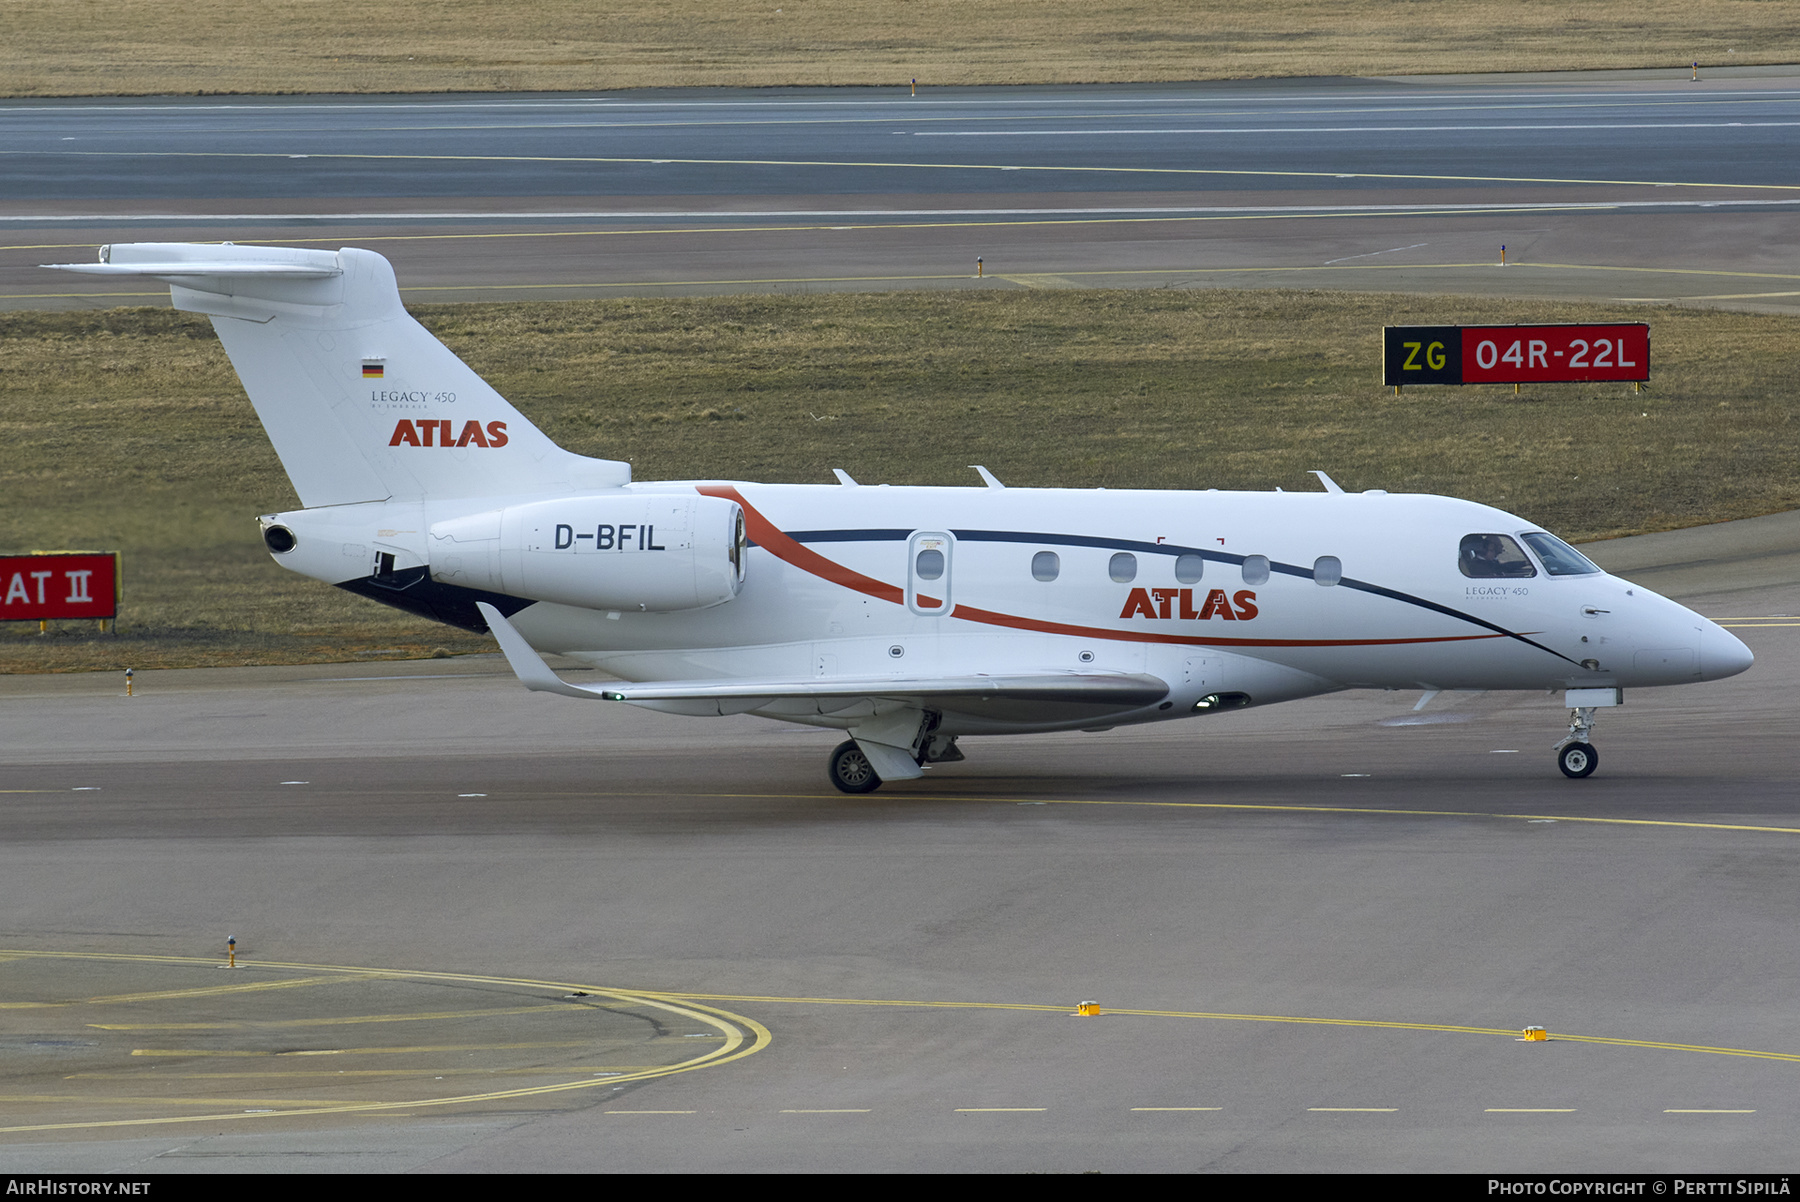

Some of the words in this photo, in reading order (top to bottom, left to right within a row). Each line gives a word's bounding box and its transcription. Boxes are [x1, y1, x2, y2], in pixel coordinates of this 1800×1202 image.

[1403, 341, 1446, 370] ZG
[1476, 338, 1636, 369] 04R-22L
[434, 392, 456, 403] 450
[388, 419, 509, 448] ATLAS
[555, 524, 666, 551] D-BFIL
[0, 571, 52, 605] AT
[65, 570, 93, 603] II
[1512, 587, 1529, 596] 450
[1119, 587, 1259, 621] ATLAS
